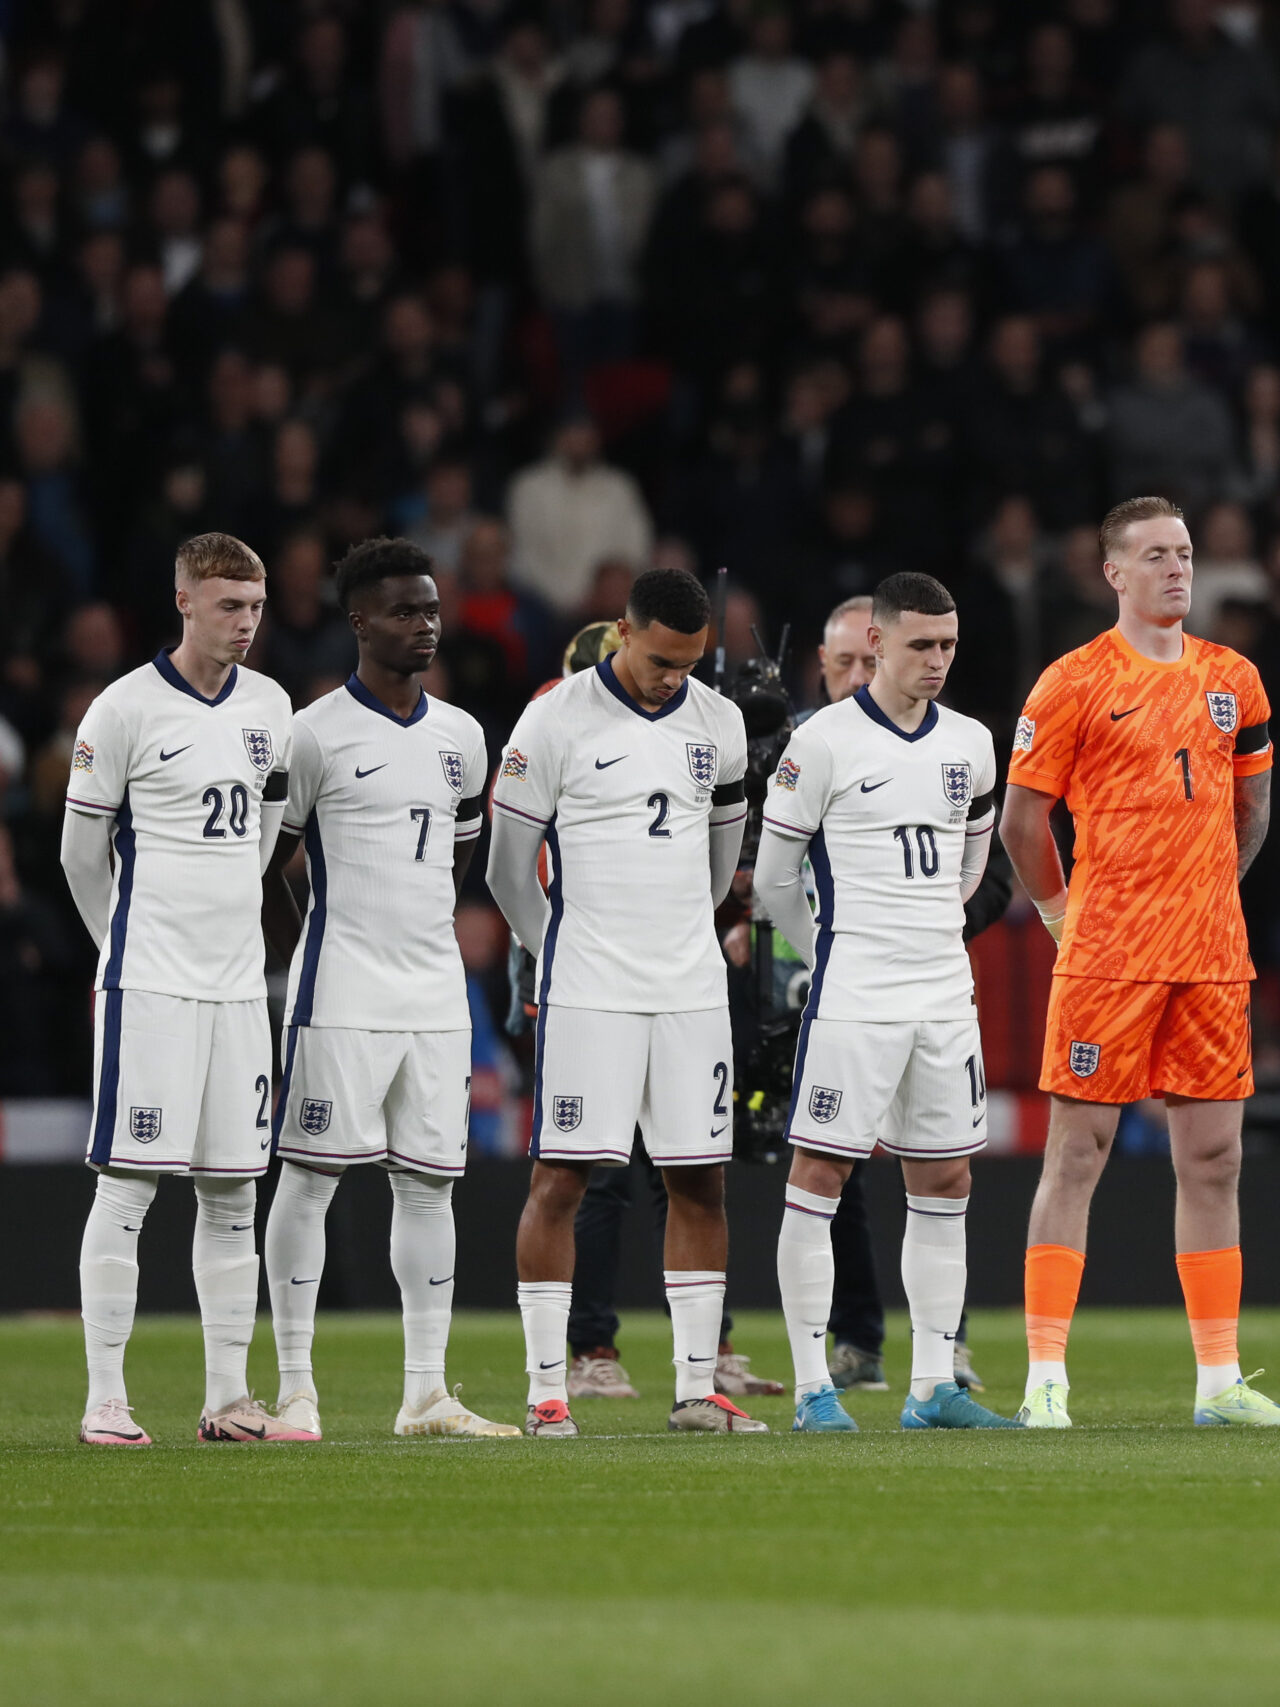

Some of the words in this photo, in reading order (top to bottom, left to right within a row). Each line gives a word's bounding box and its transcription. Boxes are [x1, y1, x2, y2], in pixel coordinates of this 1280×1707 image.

[1173, 748, 1194, 801] 1
[201, 784, 249, 839] 20
[409, 808, 431, 863] 7
[646, 790, 671, 838] 2
[893, 825, 940, 880] 10
[713, 1061, 730, 1118] 2
